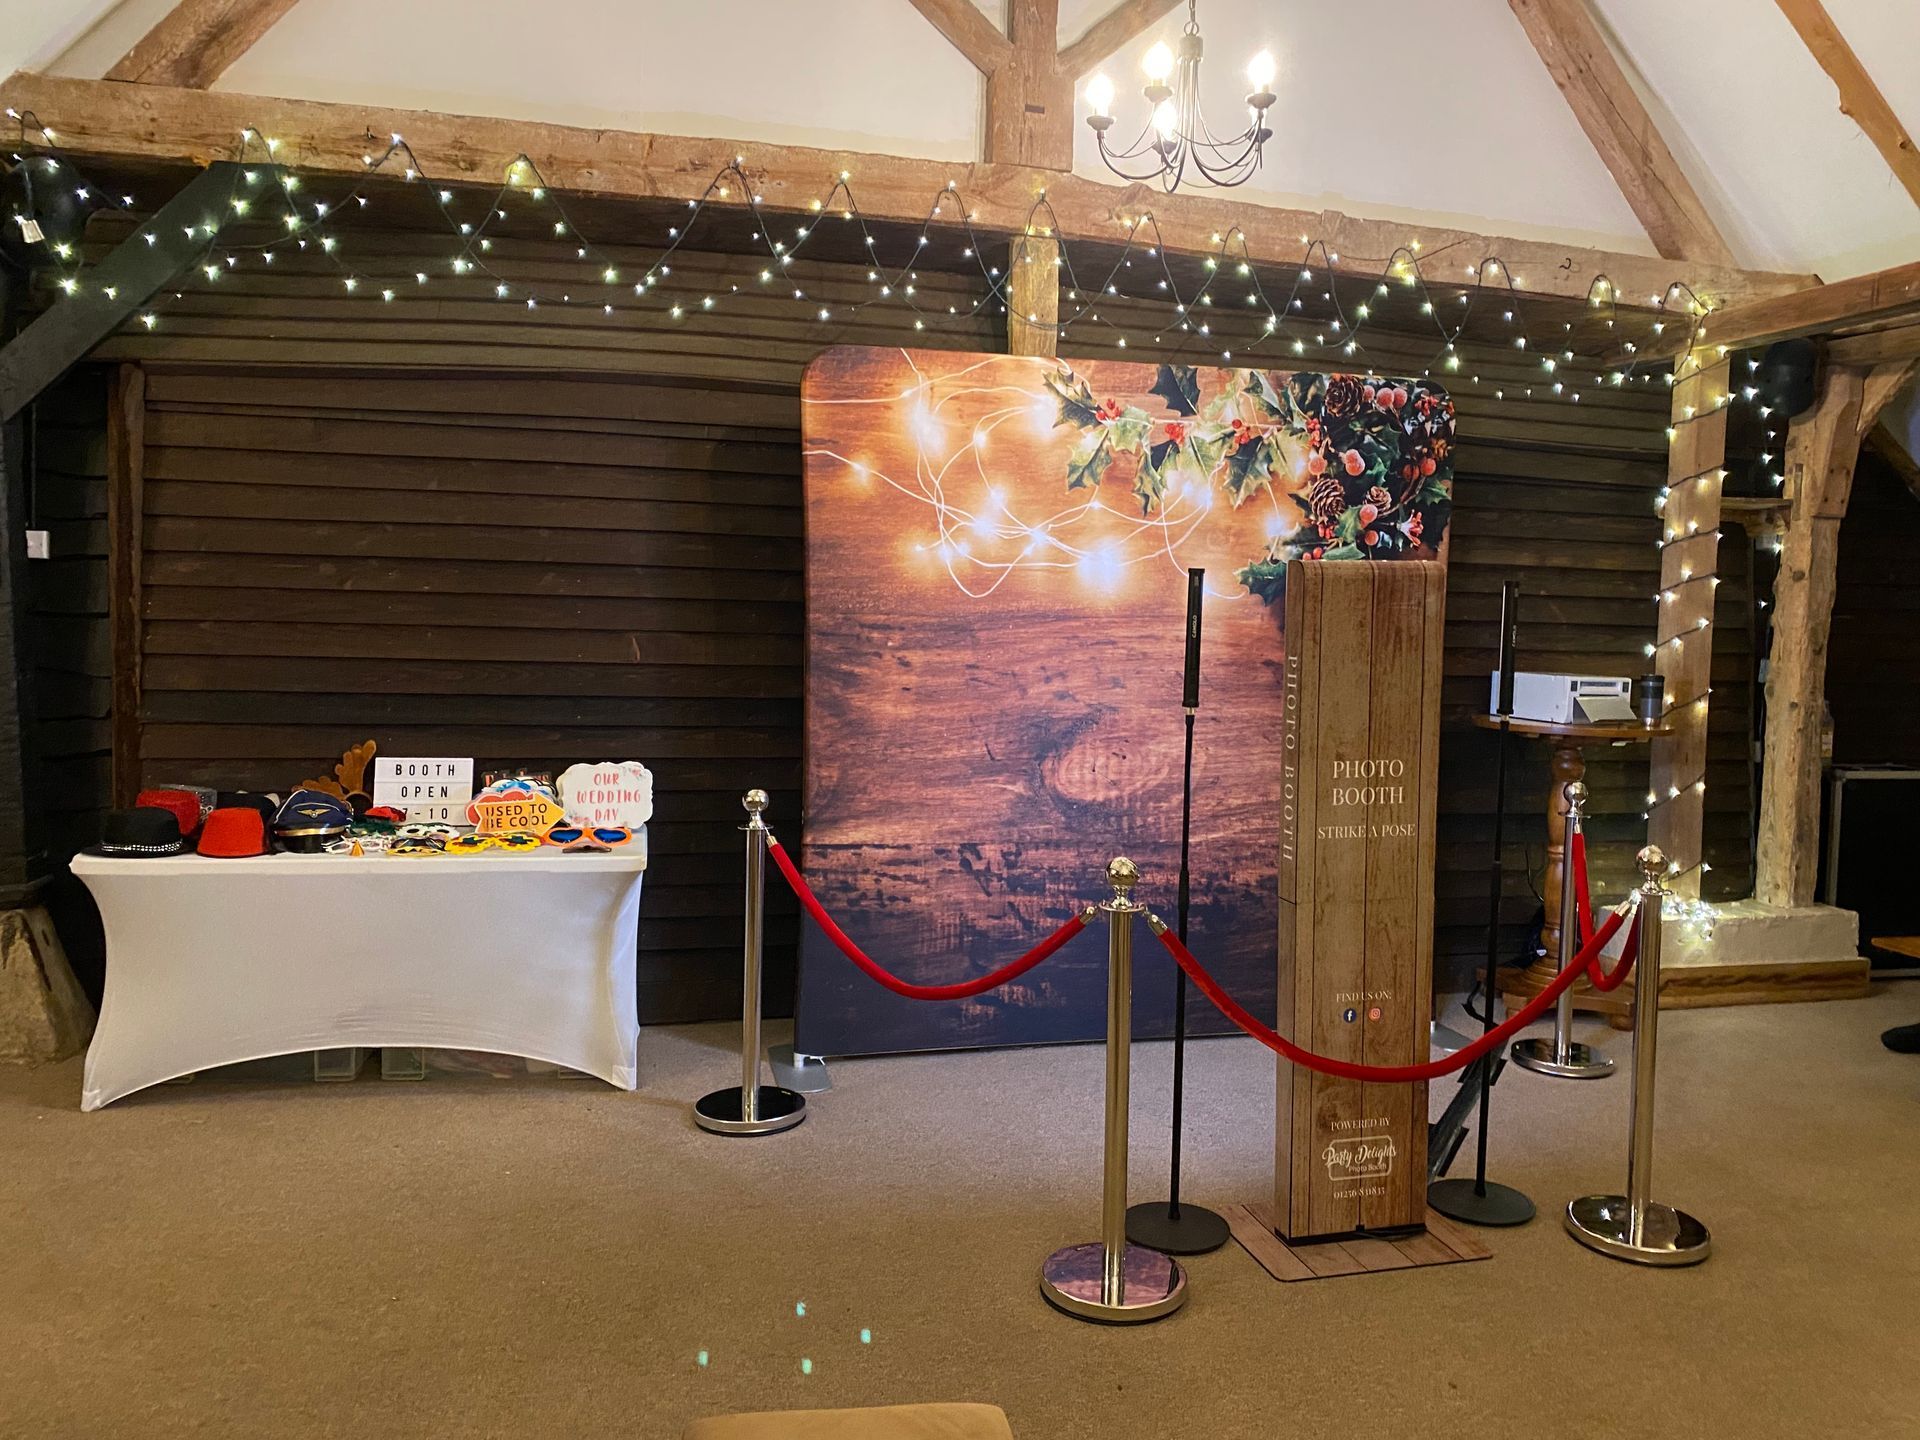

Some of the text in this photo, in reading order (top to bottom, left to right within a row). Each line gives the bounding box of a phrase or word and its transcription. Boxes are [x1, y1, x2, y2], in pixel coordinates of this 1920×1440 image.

[1283, 655, 1298, 861] PHOTO BOOTH
[395, 764, 455, 776] BOOTH
[1332, 759, 1404, 779] PHOTO
[593, 773, 619, 785] OUR
[401, 786, 448, 798] OPEN
[576, 789, 641, 804] WEDDING
[1332, 786, 1404, 806] BOOTH
[485, 803, 548, 817] USED TO
[594, 808, 619, 821] DAY
[509, 815, 548, 827] COOL
[1318, 823, 1416, 839] STRIKE A POSE
[1336, 992, 1359, 1003] FIND
[1361, 991, 1373, 1001] US
[1331, 1116, 1391, 1131] POWERED BY
[1321, 1144, 1396, 1168] Party Delights
[1348, 1162, 1387, 1173] Photo Booth
